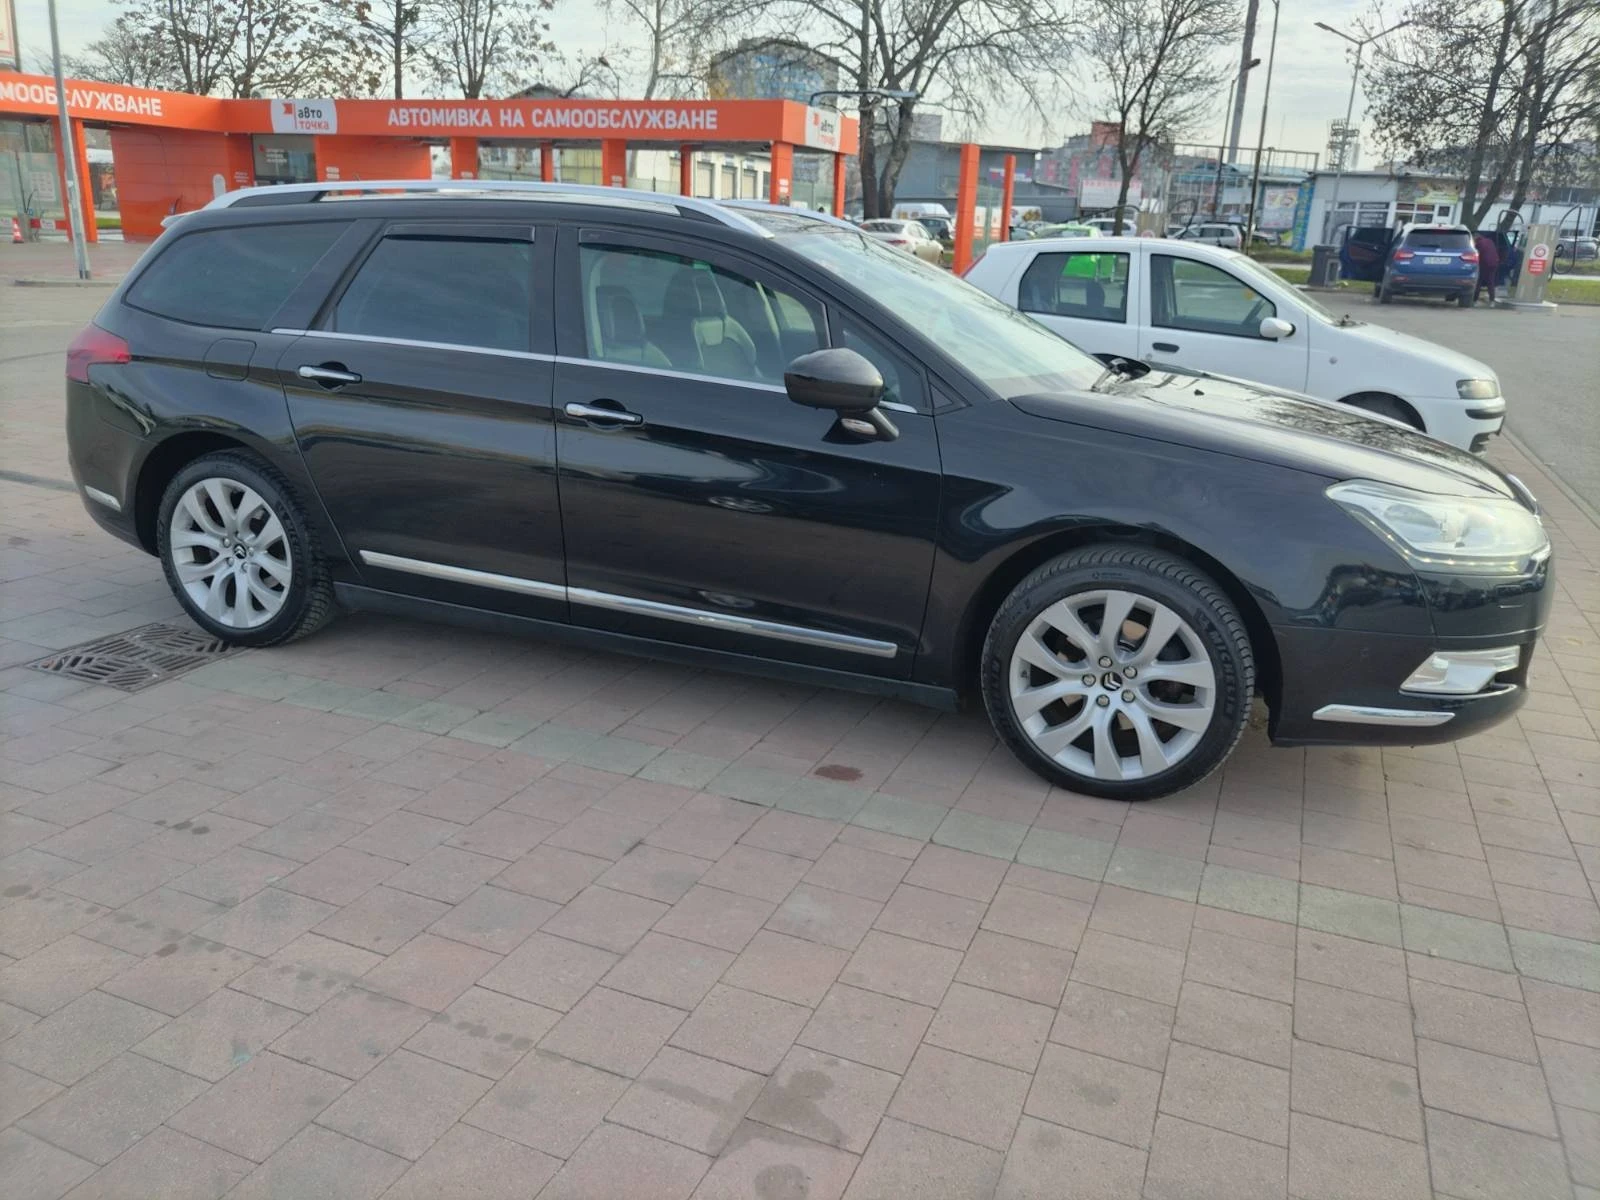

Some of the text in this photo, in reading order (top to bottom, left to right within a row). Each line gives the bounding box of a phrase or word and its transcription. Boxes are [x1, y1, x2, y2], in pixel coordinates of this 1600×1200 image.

[297, 106, 323, 119] авто
[387, 107, 719, 131] АВТОМИВКА НА САМООБСЛУЖВАНЕ
[299, 120, 330, 131] точка
